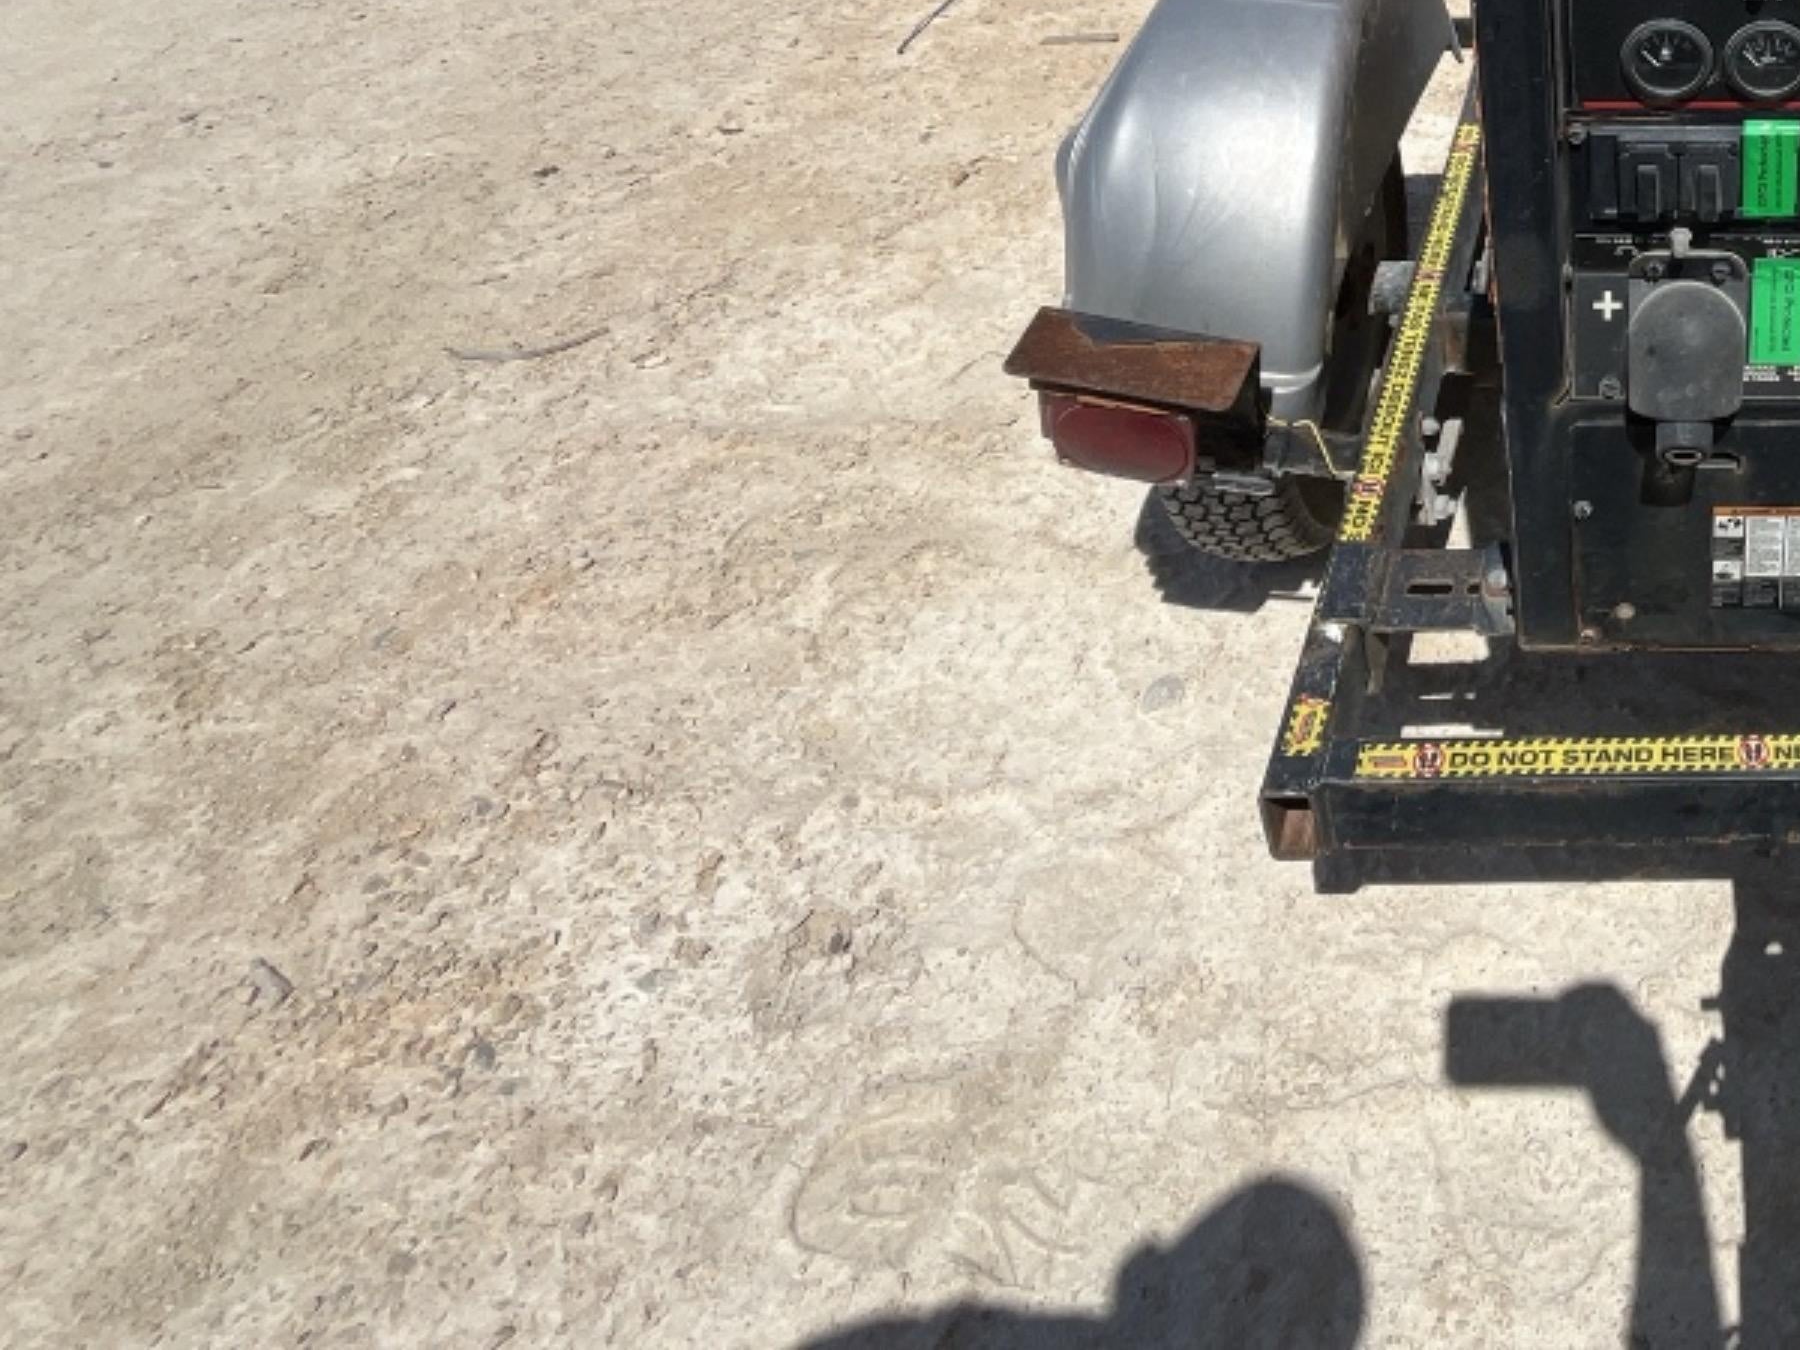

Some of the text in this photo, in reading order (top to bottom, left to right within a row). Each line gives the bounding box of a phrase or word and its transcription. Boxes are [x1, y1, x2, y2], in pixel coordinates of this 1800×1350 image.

[1449, 745, 1734, 769] DO NOT STAND HERE
